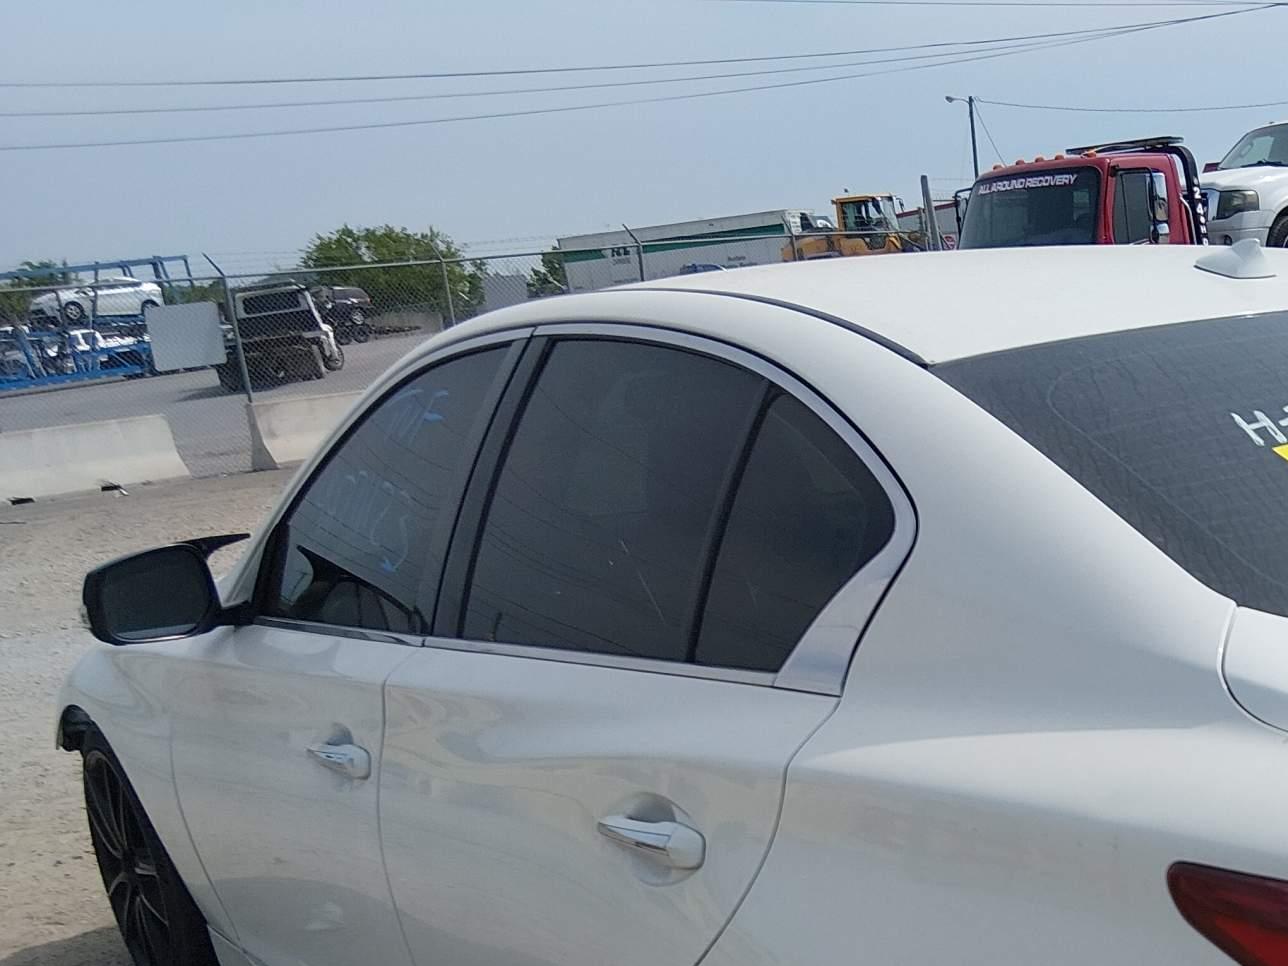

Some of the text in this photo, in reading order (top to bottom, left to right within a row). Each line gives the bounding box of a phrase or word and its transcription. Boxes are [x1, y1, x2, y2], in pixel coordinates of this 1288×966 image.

[978, 174, 1078, 195] ALL AROUND RECOVERY
